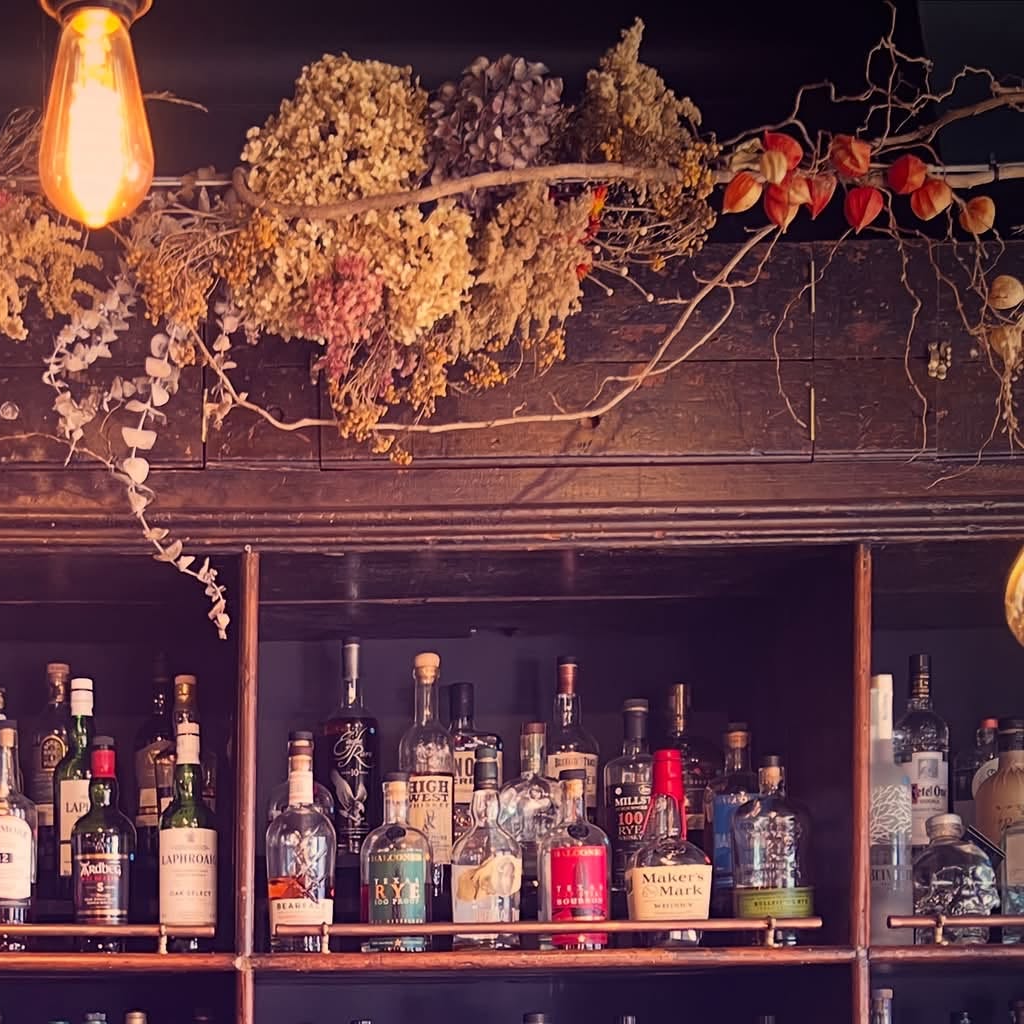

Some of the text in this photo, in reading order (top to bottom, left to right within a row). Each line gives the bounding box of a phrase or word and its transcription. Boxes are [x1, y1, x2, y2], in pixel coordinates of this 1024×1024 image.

[618, 811, 644, 825] 100
[642, 872, 705, 885] Maker's
[375, 884, 421, 899] RYE
[659, 885, 703, 896] Mark
